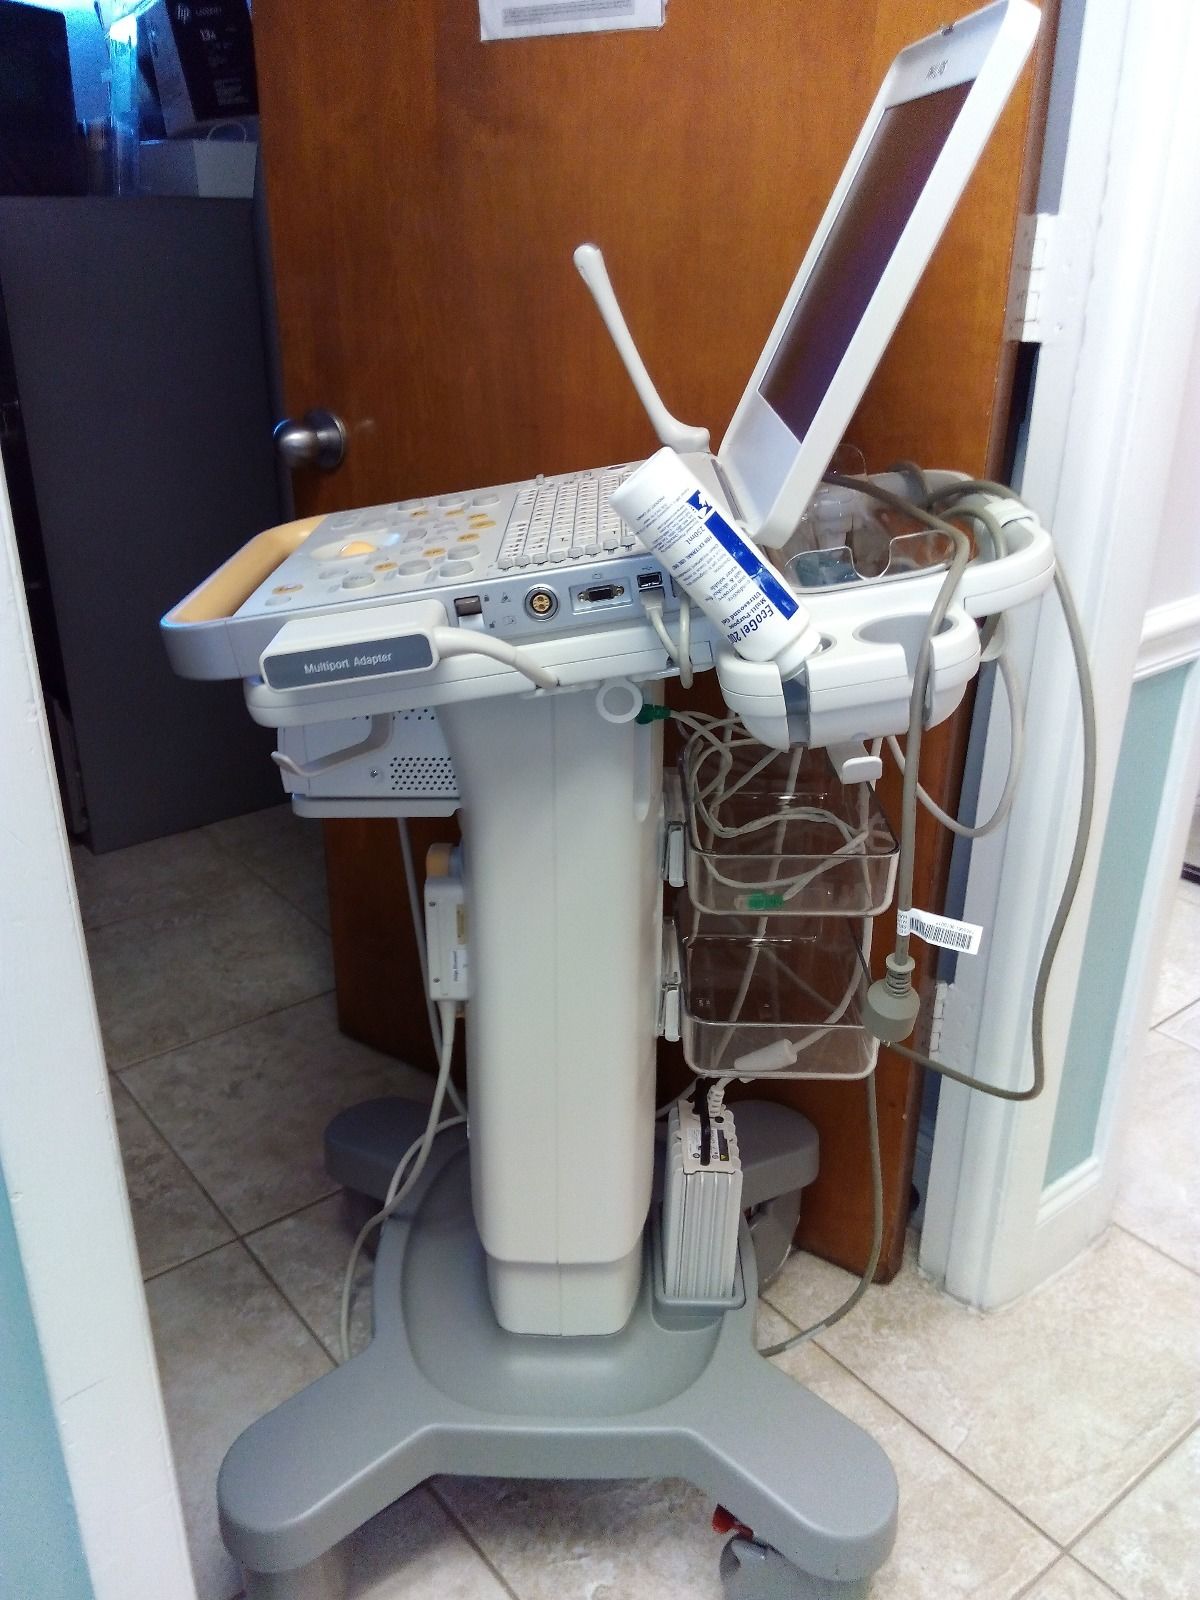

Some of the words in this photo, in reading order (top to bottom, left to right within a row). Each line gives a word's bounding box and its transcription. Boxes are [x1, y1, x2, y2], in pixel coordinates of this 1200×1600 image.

[727, 597, 767, 629] Multi-Purpose
[729, 590, 761, 620] Ultrasound
[739, 603, 775, 638] EcoGel
[304, 658, 350, 675] Multiport
[353, 652, 392, 668] Adapter
